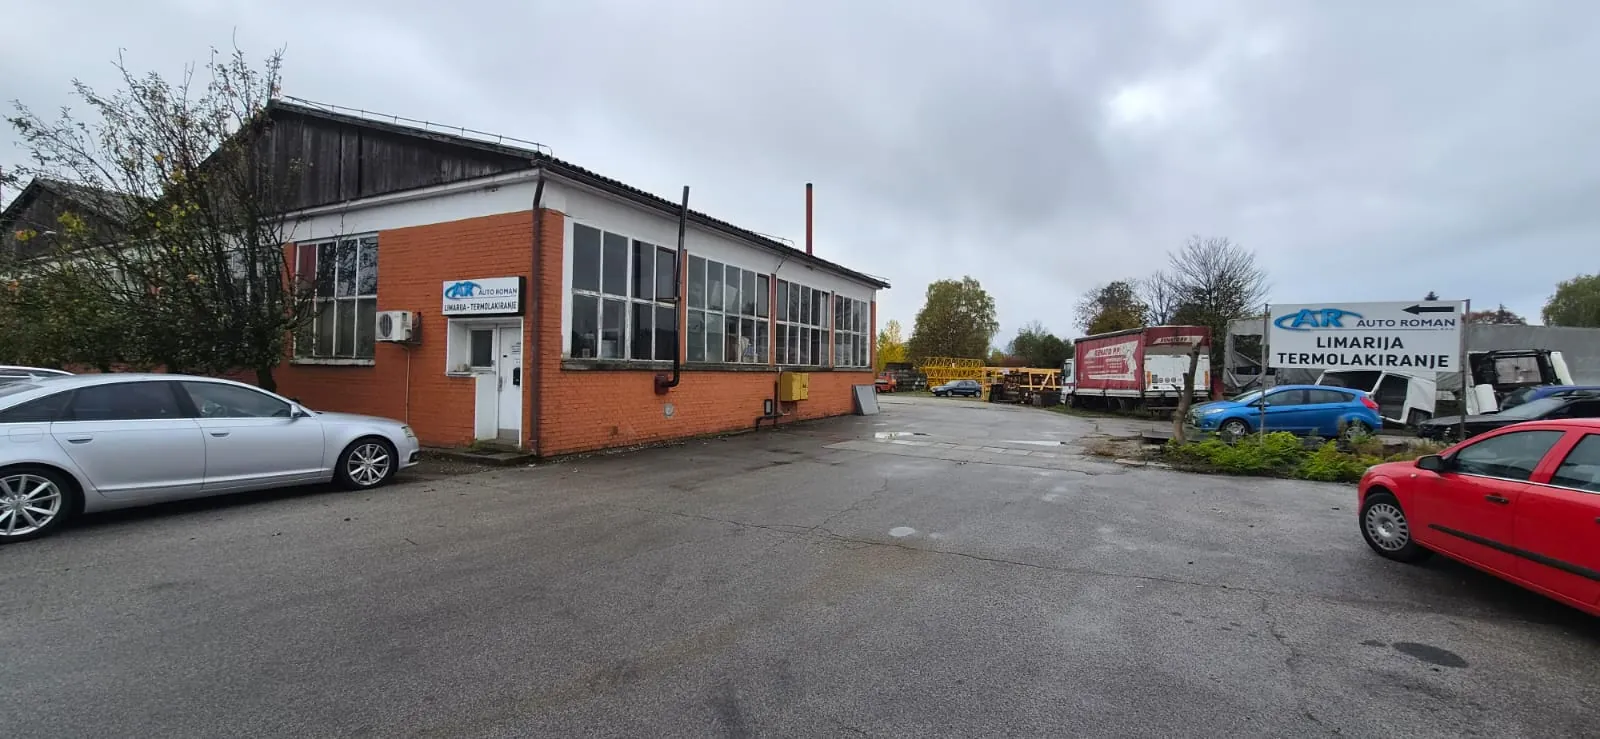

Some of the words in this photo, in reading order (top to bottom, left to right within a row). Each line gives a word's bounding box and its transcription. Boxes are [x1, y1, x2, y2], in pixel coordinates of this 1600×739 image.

[479, 288, 495, 296] AUTO
[495, 287, 517, 296] ROMAN
[470, 301, 517, 312] TERMOLAKIRANJE
[1291, 308, 1344, 328] AR
[1356, 319, 1396, 328] AUTO
[1400, 318, 1456, 327] ROMAN
[1316, 336, 1404, 350] LIMARIJA
[1277, 352, 1449, 369] TERMOLAKIRANJE
